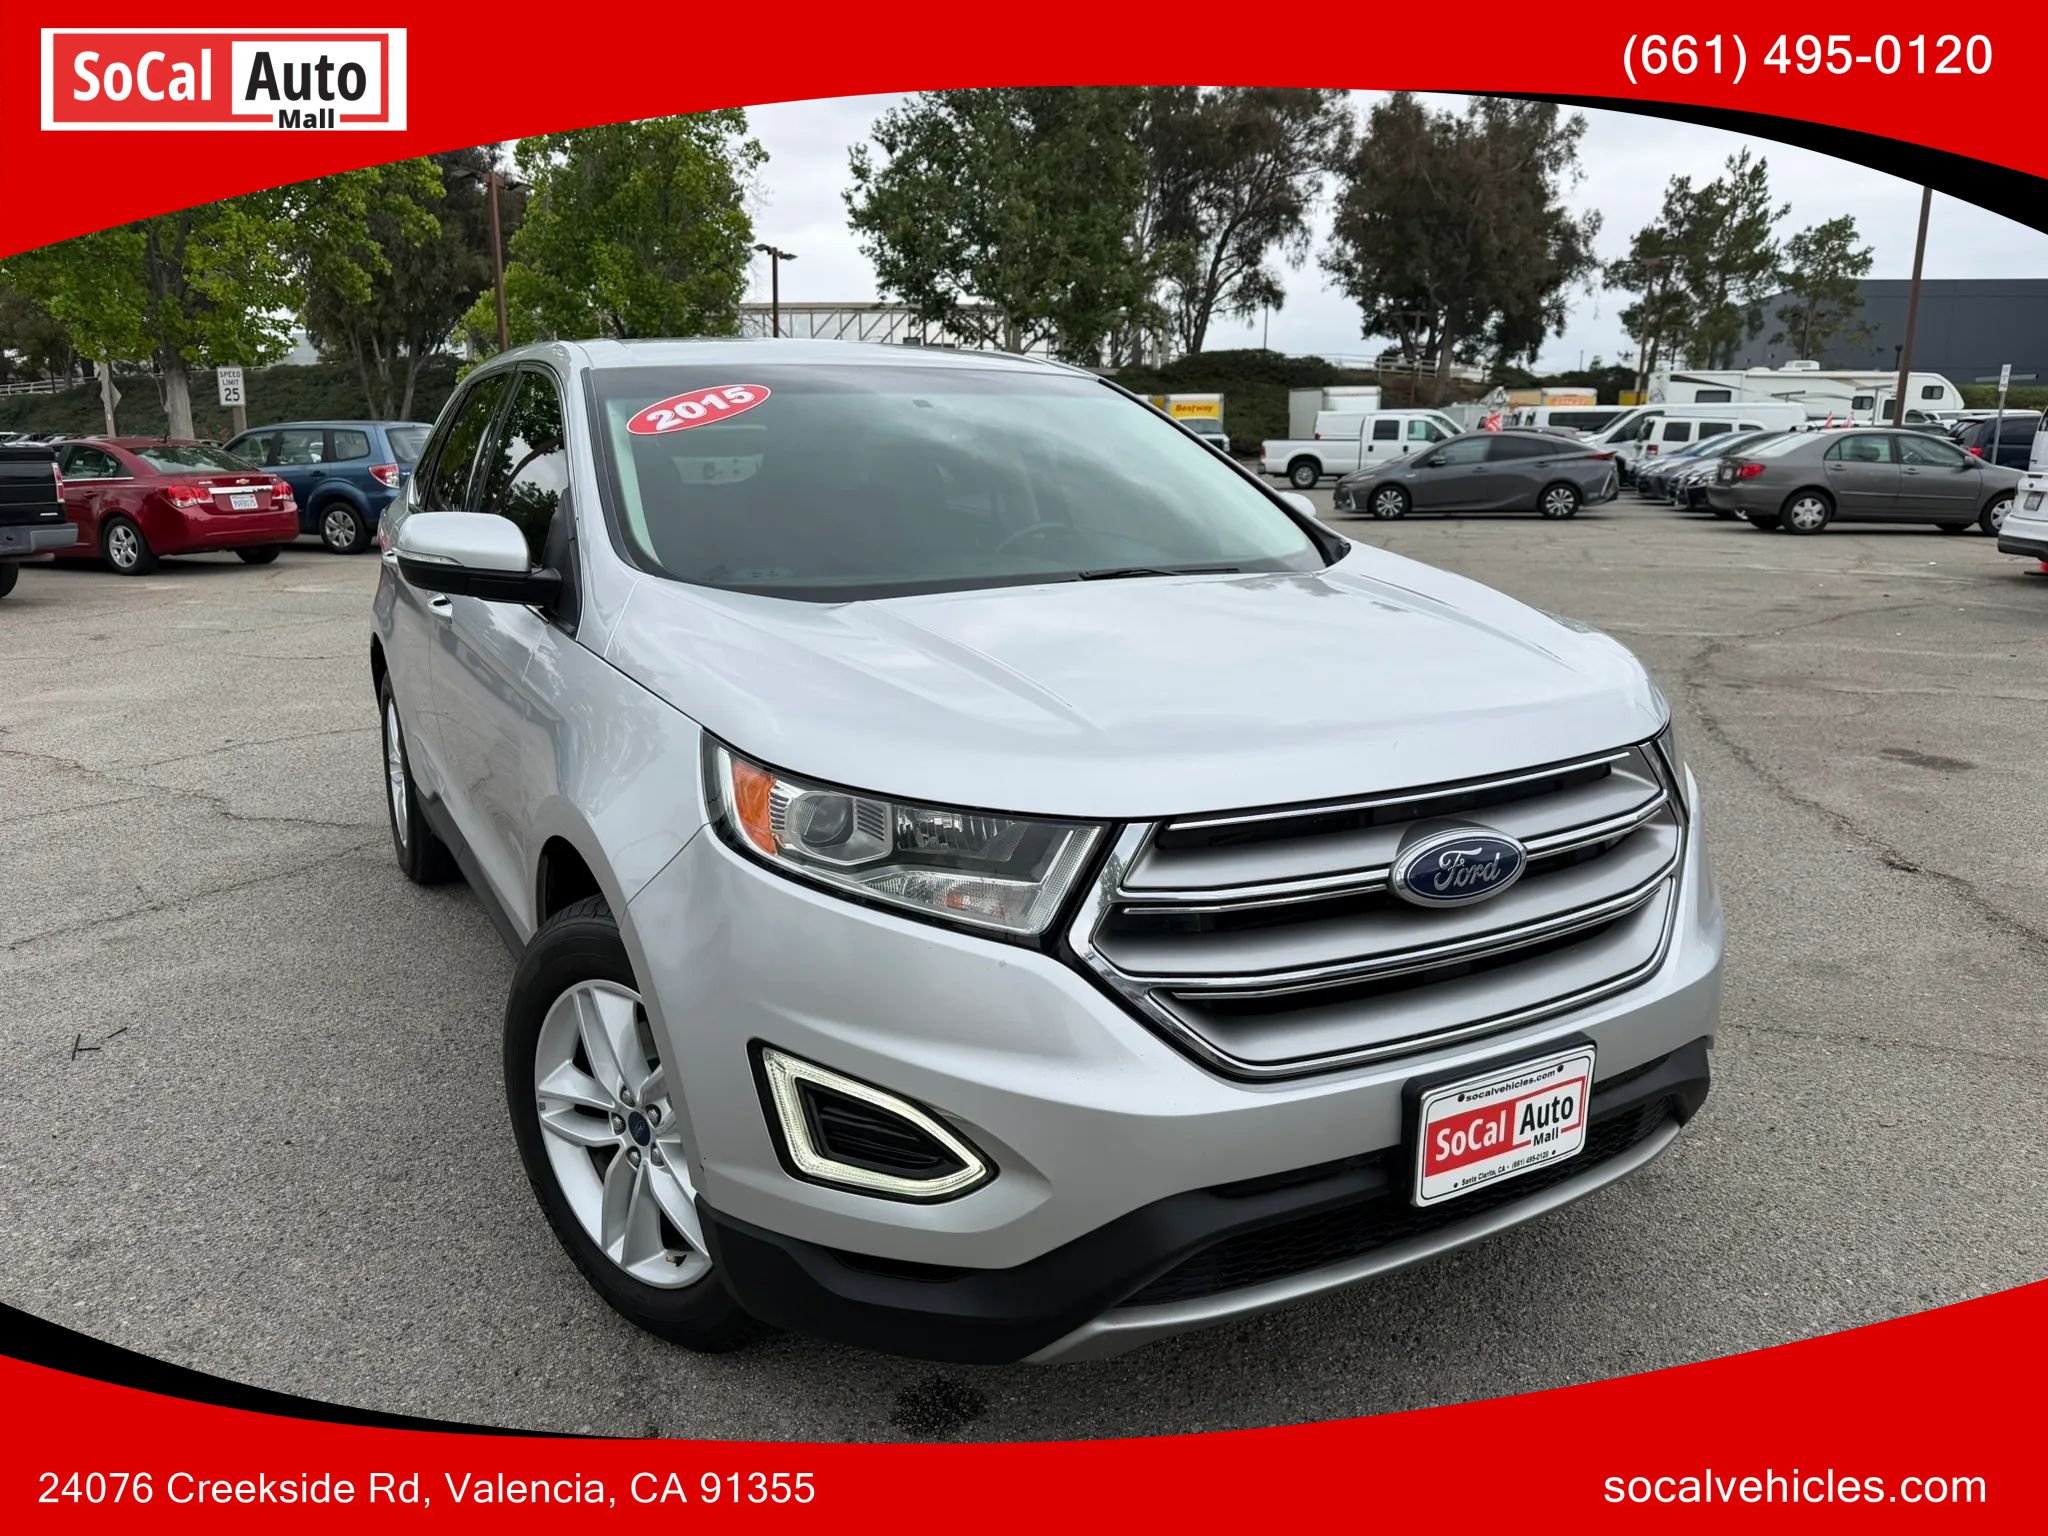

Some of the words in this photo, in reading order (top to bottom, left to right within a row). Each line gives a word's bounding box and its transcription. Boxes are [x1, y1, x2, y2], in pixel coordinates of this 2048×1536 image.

[224, 388, 240, 401] 25
[646, 386, 756, 431] 2015
[1433, 847, 1501, 892] Ford
[1465, 1070, 1556, 1102] socalvehicles.com
[1435, 1109, 1507, 1162] SoCal
[1519, 1095, 1574, 1136] Auto
[1533, 1127, 1559, 1147] Mall
[1461, 1175, 1477, 1186] Santa
[1478, 1169, 1497, 1180] Clarita,
[1498, 1165, 1506, 1173] CA
[1511, 1158, 1526, 1169] (661)
